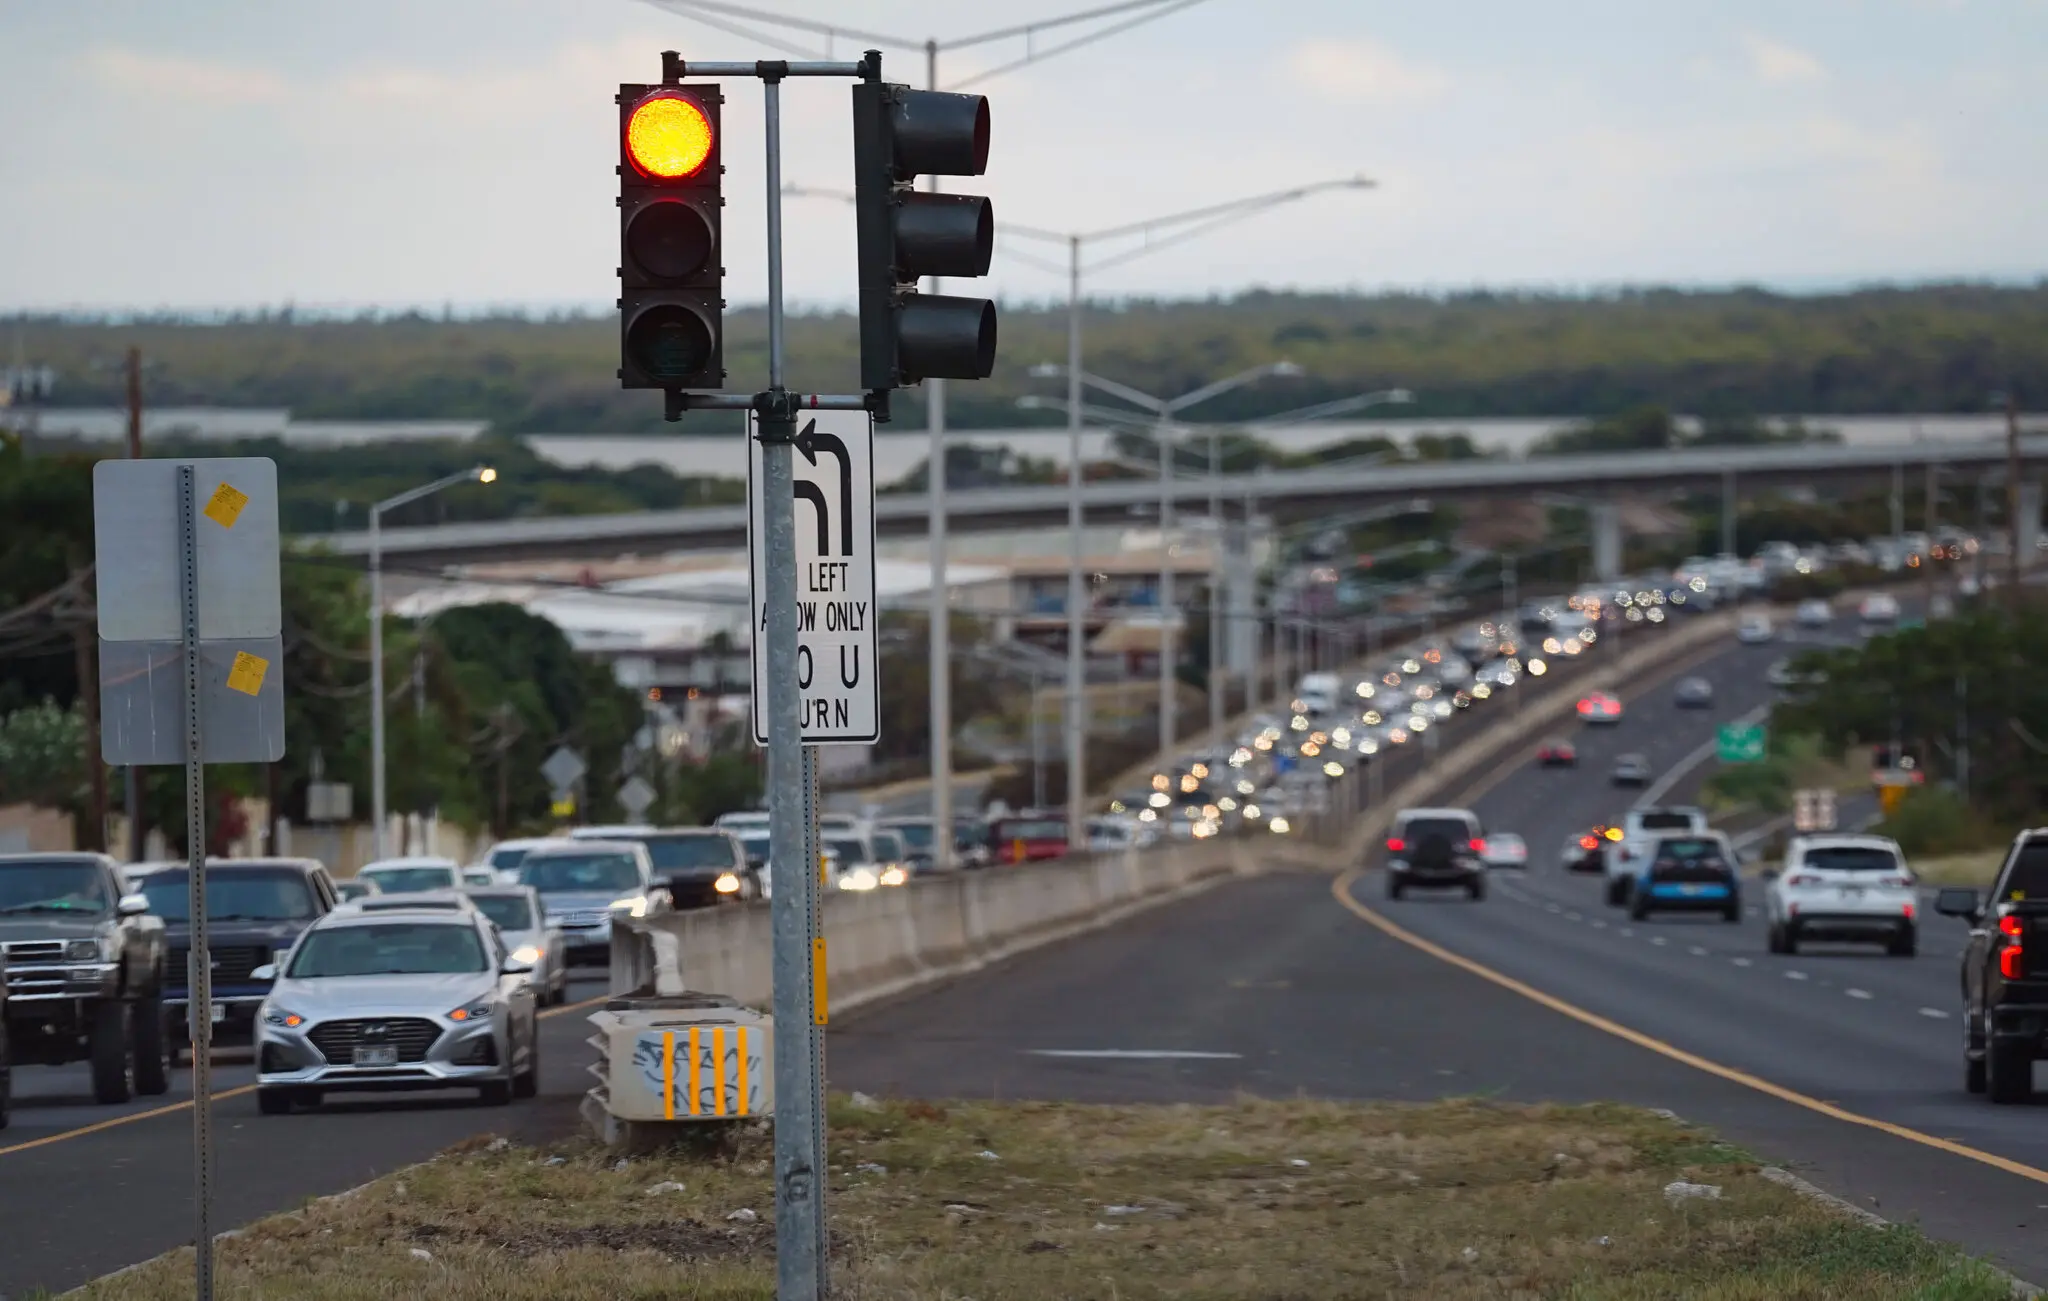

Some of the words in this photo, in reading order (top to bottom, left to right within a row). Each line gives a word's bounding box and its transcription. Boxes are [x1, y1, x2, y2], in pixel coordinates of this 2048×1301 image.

[809, 562, 848, 592] LEFT
[826, 601, 867, 632] ONLY
[798, 645, 813, 690] O
[840, 645, 859, 689] U
[800, 698, 848, 729] URN
